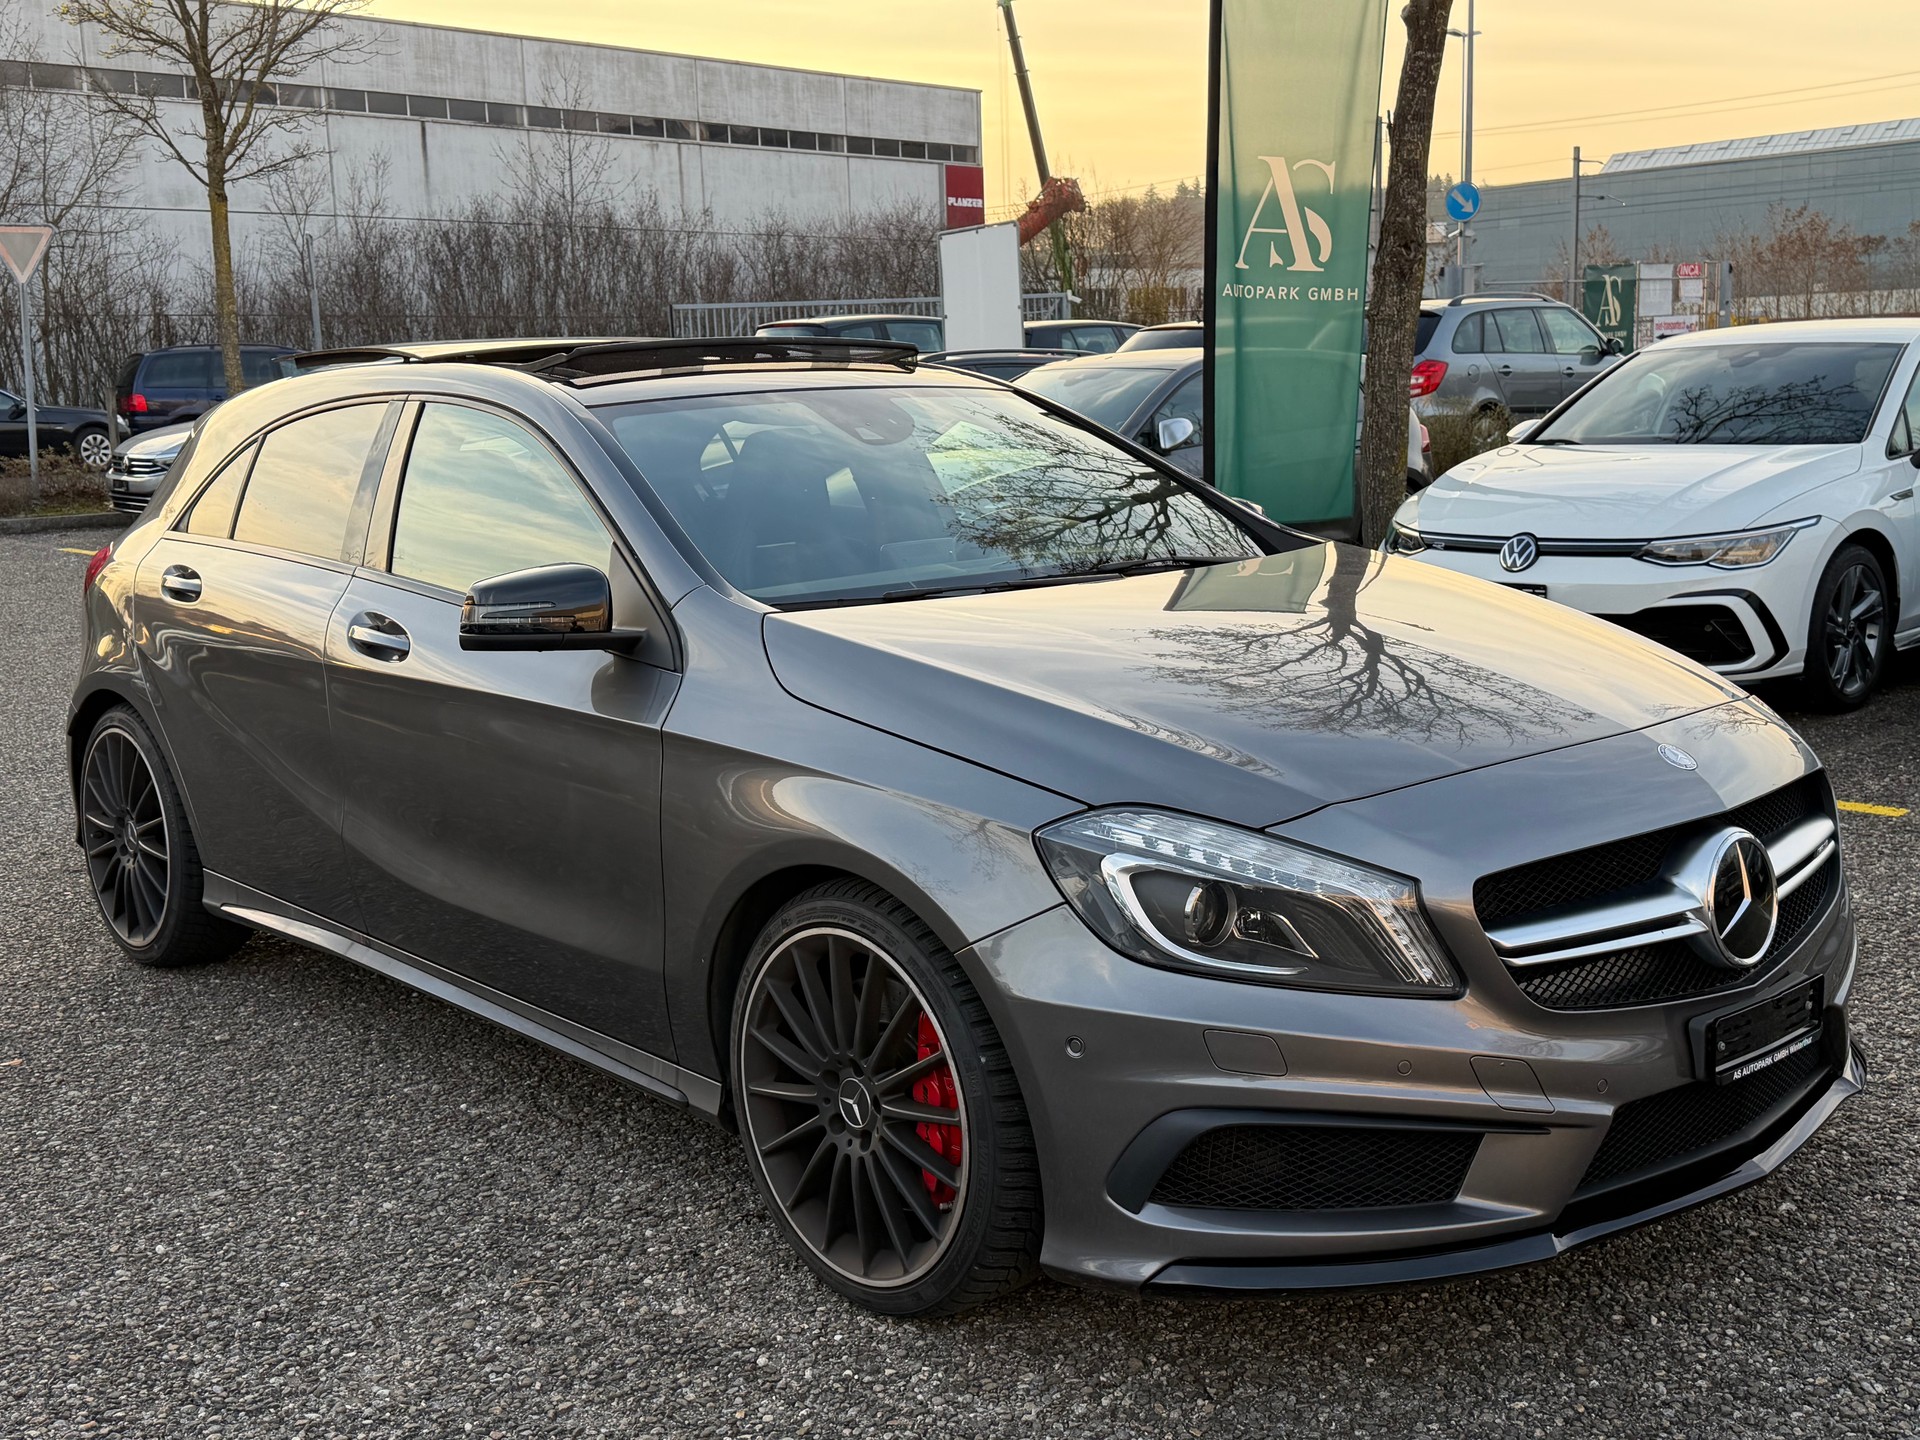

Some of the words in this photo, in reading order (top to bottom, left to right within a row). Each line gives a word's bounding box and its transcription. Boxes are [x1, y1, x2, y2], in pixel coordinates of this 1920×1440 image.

[1234, 155, 1336, 272] AS
[1222, 283, 1300, 300] AUTOPARK
[1307, 287, 1359, 301] GMBH
[1733, 1069, 1742, 1080] AS
[1742, 1056, 1773, 1076] AUTOPARK
[1773, 1047, 1789, 1062] GMBH
